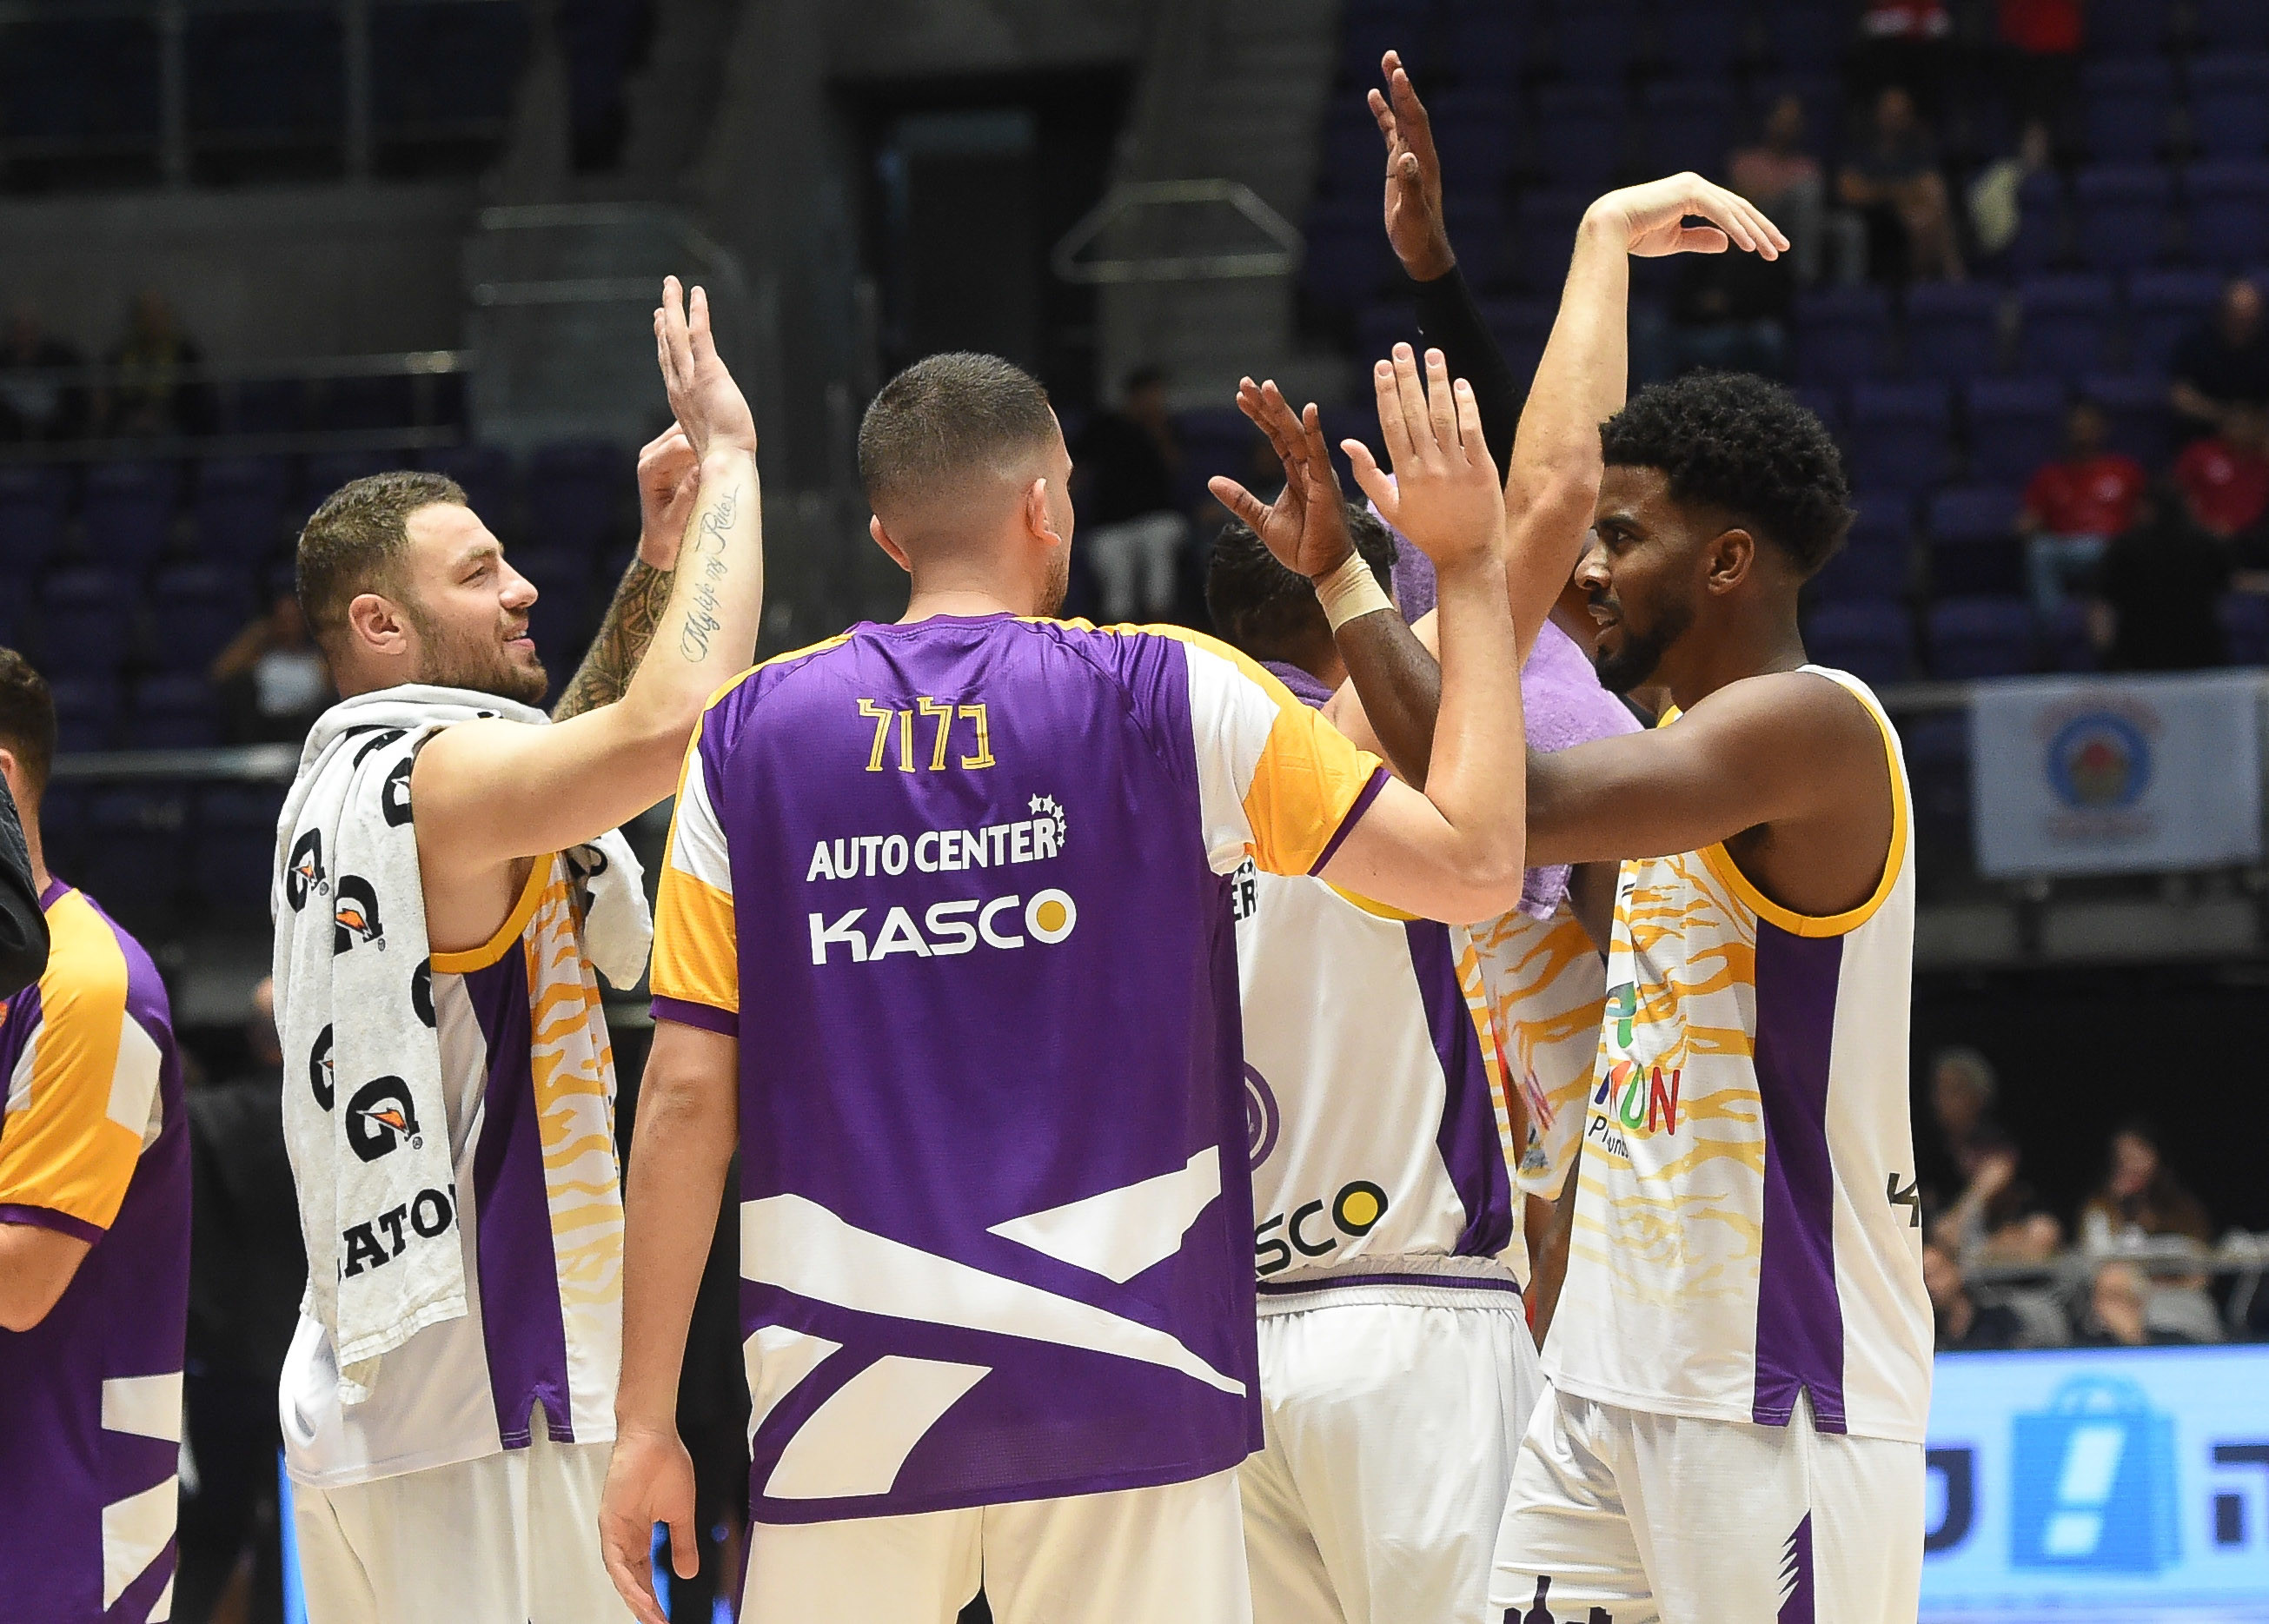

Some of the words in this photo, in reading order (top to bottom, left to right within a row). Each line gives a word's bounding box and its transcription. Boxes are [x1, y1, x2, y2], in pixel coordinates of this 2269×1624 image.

[695, 484, 740, 554] Rules
[693, 583, 721, 611] life
[680, 611, 720, 662] My
[856, 696, 996, 772] בלול
[806, 839, 909, 882] AUTO
[914, 818, 1058, 872] CENTER
[809, 888, 1077, 964] KASCO
[338, 1183, 458, 1284] ATO
